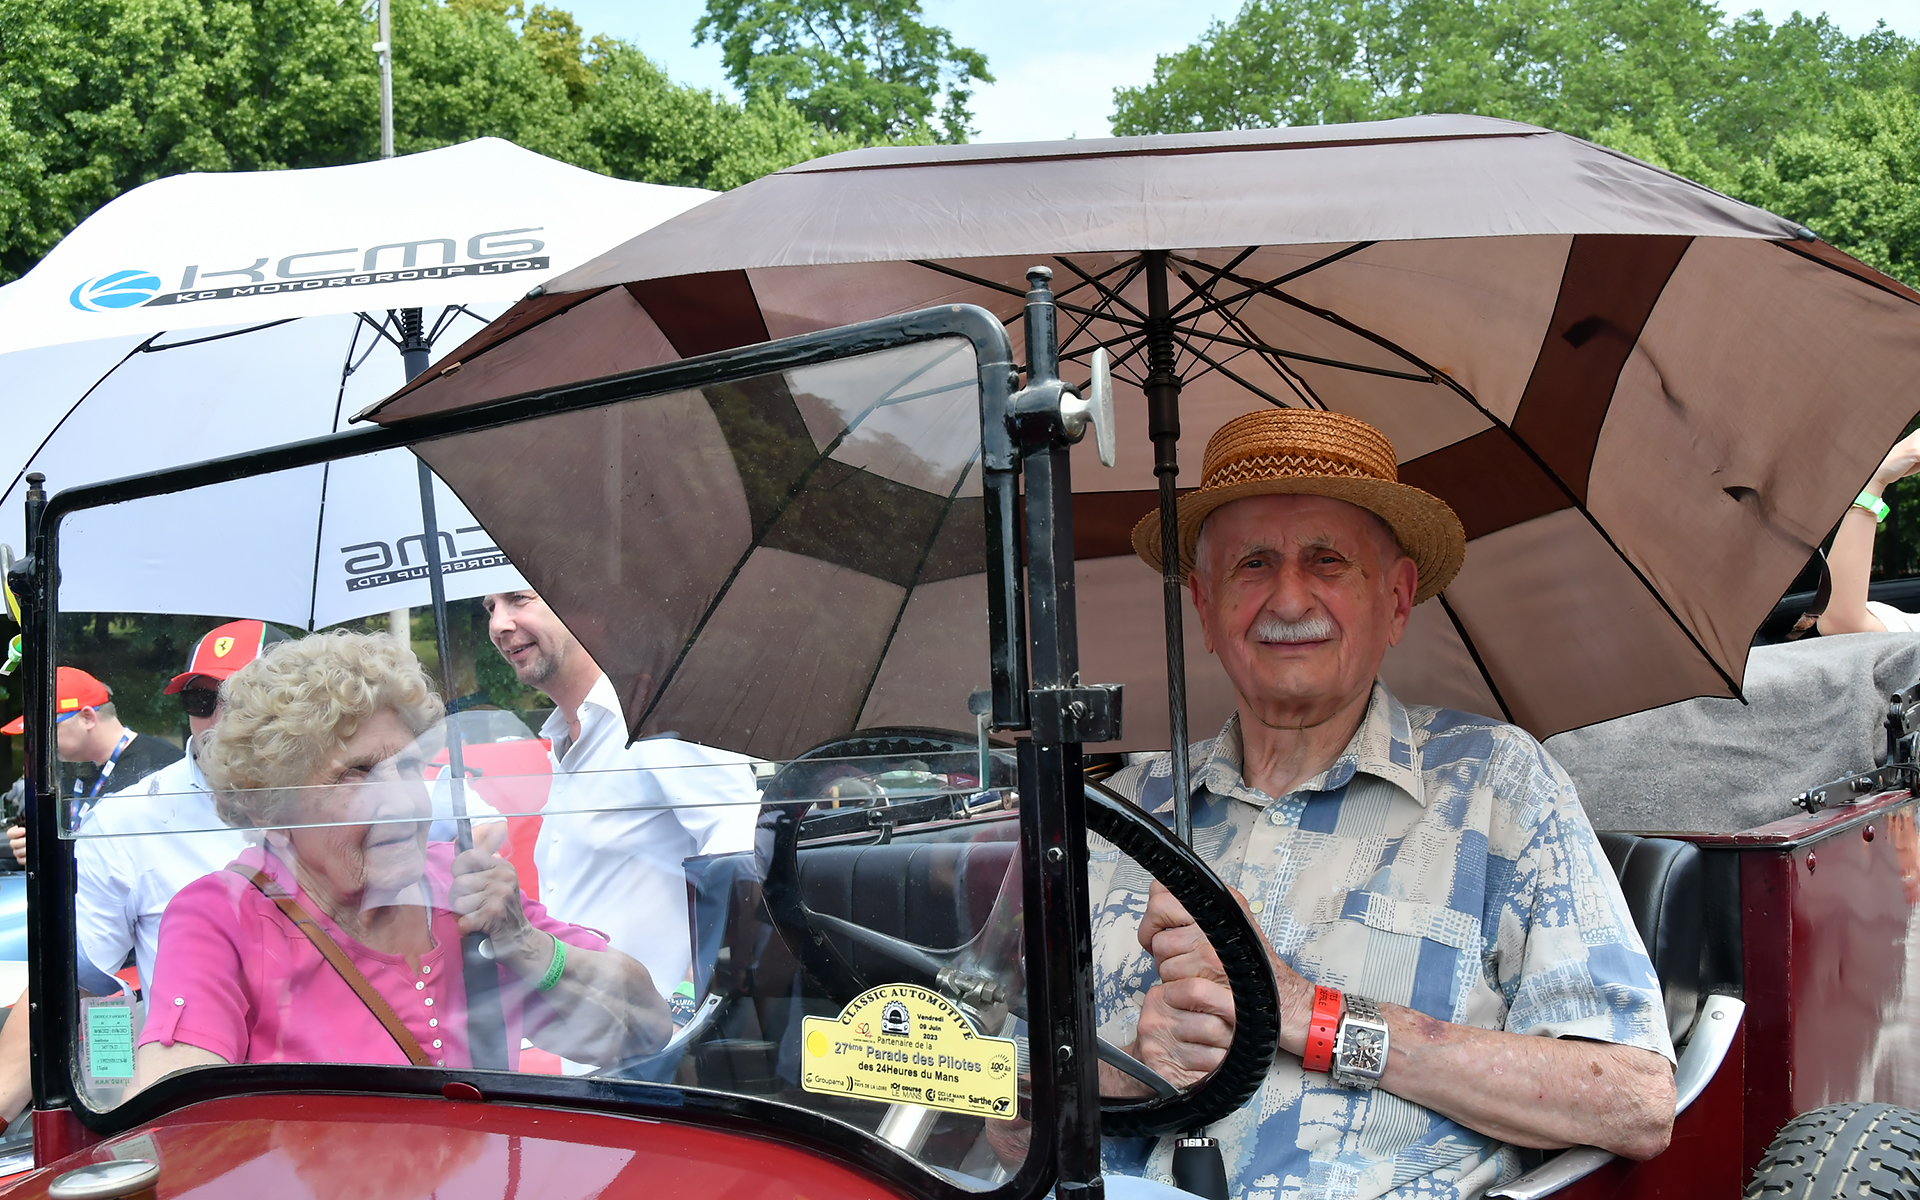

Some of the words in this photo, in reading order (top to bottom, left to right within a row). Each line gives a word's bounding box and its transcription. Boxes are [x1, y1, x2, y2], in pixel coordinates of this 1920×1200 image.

[180, 226, 545, 290] KCMG
[175, 290, 218, 304] KC
[231, 266, 468, 297] MOTORGROUP
[478, 257, 542, 274] LTD.
[841, 989, 887, 1025] CLASSIC
[891, 988, 974, 1041] AUTOMOTIVE
[917, 1013, 944, 1022] Vendredi
[928, 1024, 942, 1032] Juin
[877, 1036, 913, 1048] Partenaire
[915, 1041, 924, 1049] de
[926, 1042, 933, 1050] la
[923, 1033, 938, 1041] 2023
[866, 1045, 908, 1063] Parade
[912, 1052, 934, 1066] des
[938, 1054, 982, 1073] Pilotes
[858, 1061, 874, 1071] des
[876, 1063, 918, 1078] 24Heures
[920, 1069, 932, 1079] du
[934, 1071, 960, 1083] Mans
[990, 1062, 1004, 1071] 100
[814, 1075, 845, 1087] Groupama
[892, 1089, 900, 1097] LE
[902, 1090, 922, 1100] MANS
[968, 1094, 992, 1106] Sarthe
